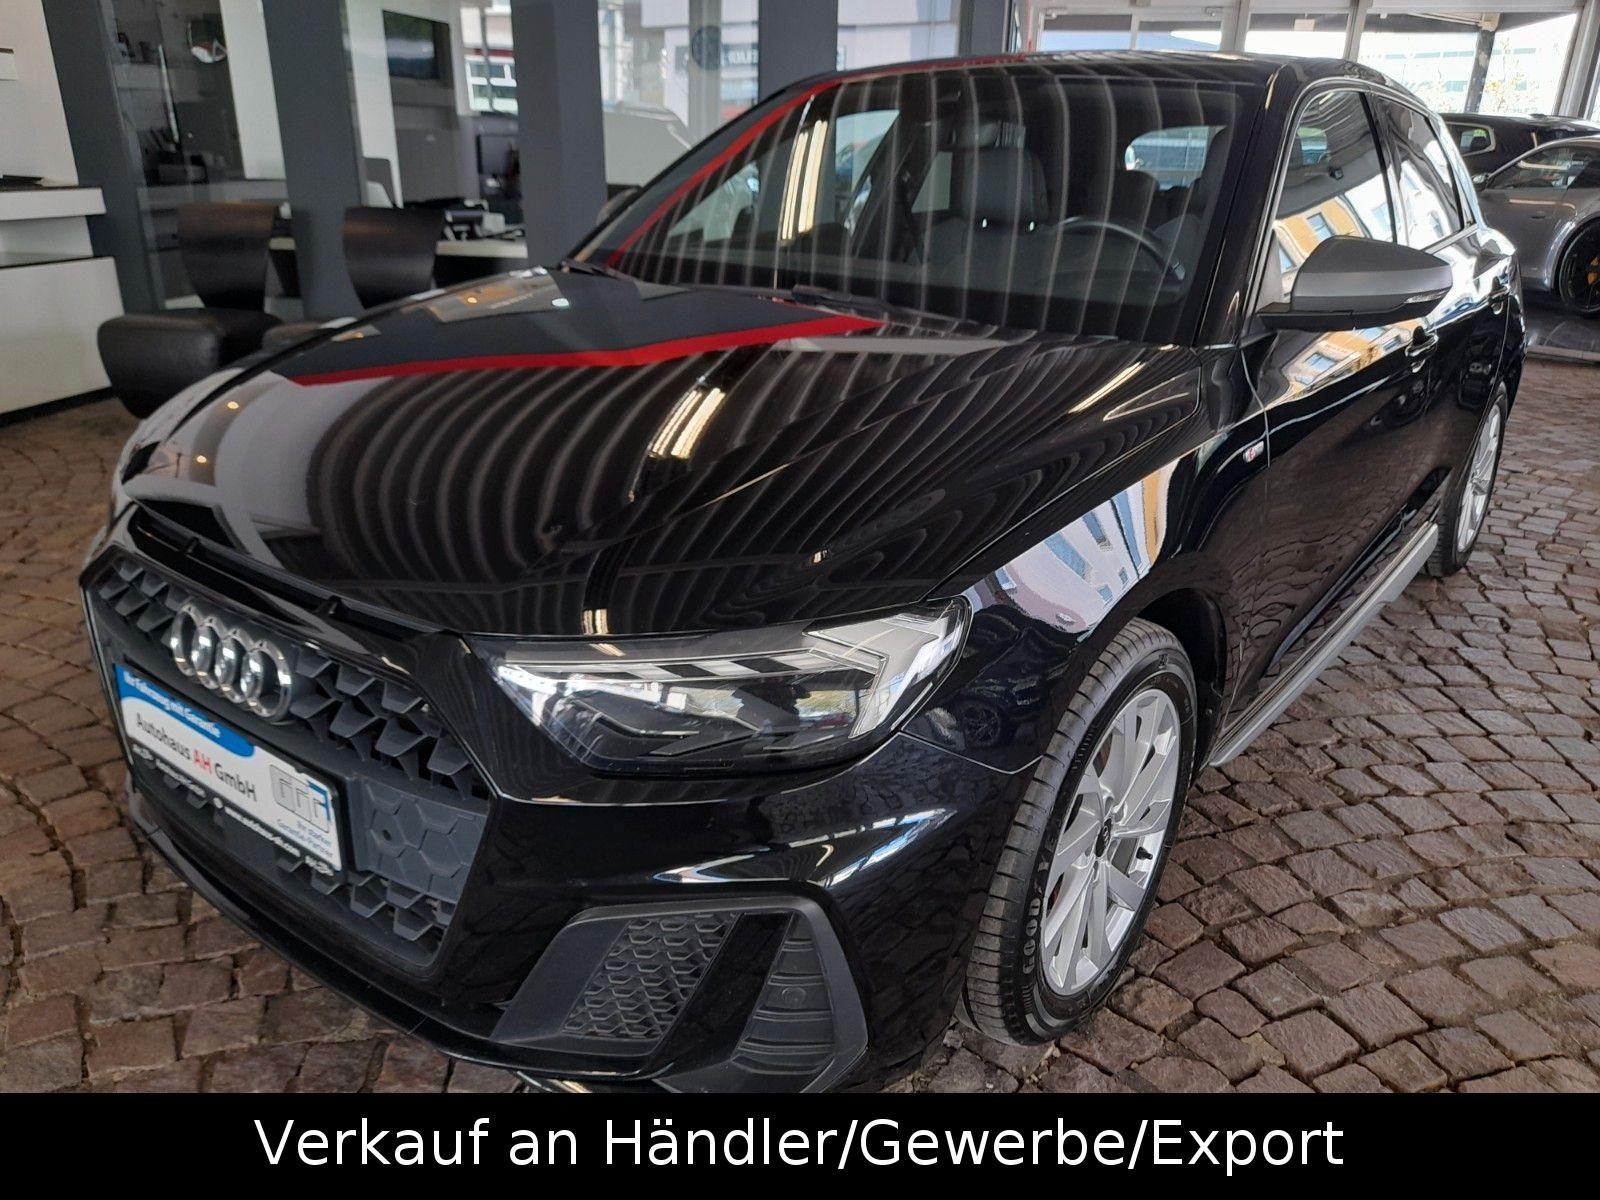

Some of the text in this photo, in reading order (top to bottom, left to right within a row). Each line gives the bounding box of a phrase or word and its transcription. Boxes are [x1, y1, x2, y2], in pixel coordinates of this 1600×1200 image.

[136, 713, 191, 760] Autohaus
[192, 749, 212, 775] AH
[214, 763, 258, 802] GmbH
